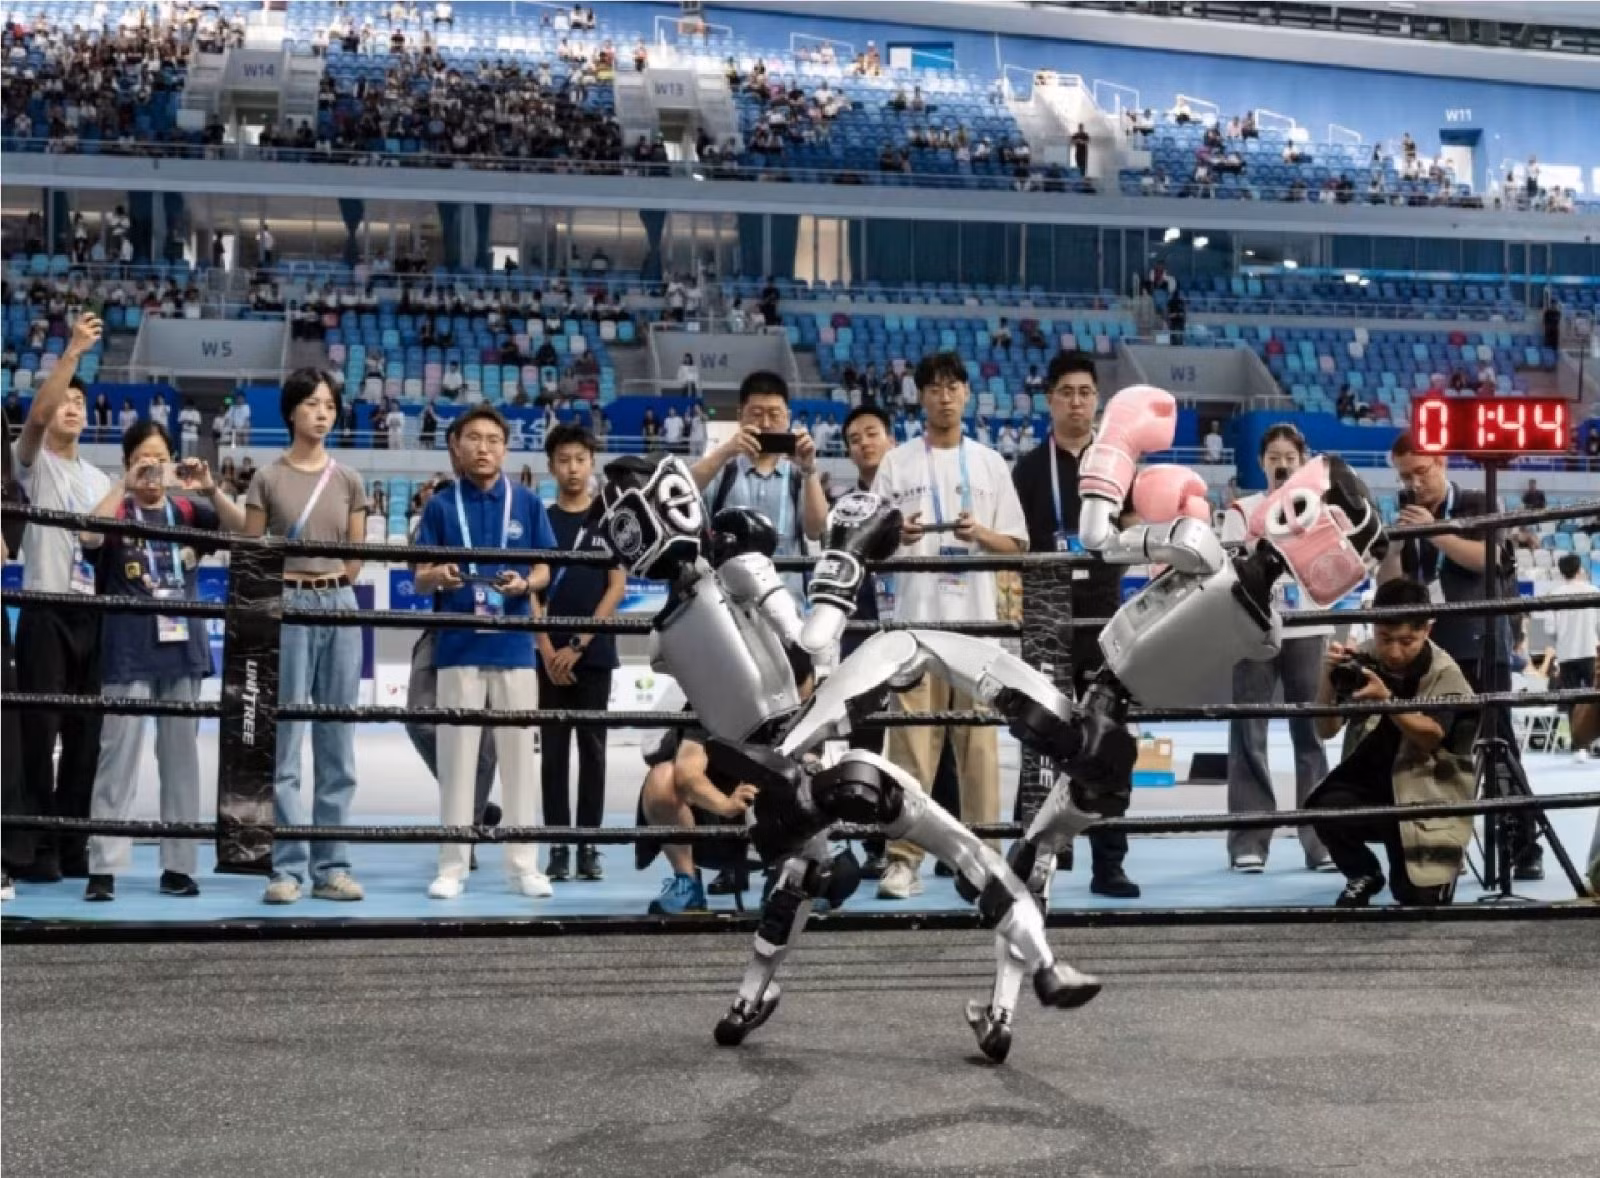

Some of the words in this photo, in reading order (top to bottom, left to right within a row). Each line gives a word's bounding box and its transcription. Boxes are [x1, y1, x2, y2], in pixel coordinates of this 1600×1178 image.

[243, 63, 274, 79] W14
[654, 82, 685, 97] W13
[1445, 108, 1472, 121] W11
[201, 340, 232, 357] W5
[700, 351, 729, 369] W4
[1170, 364, 1195, 381] W3
[1418, 400, 1564, 451] 01:44
